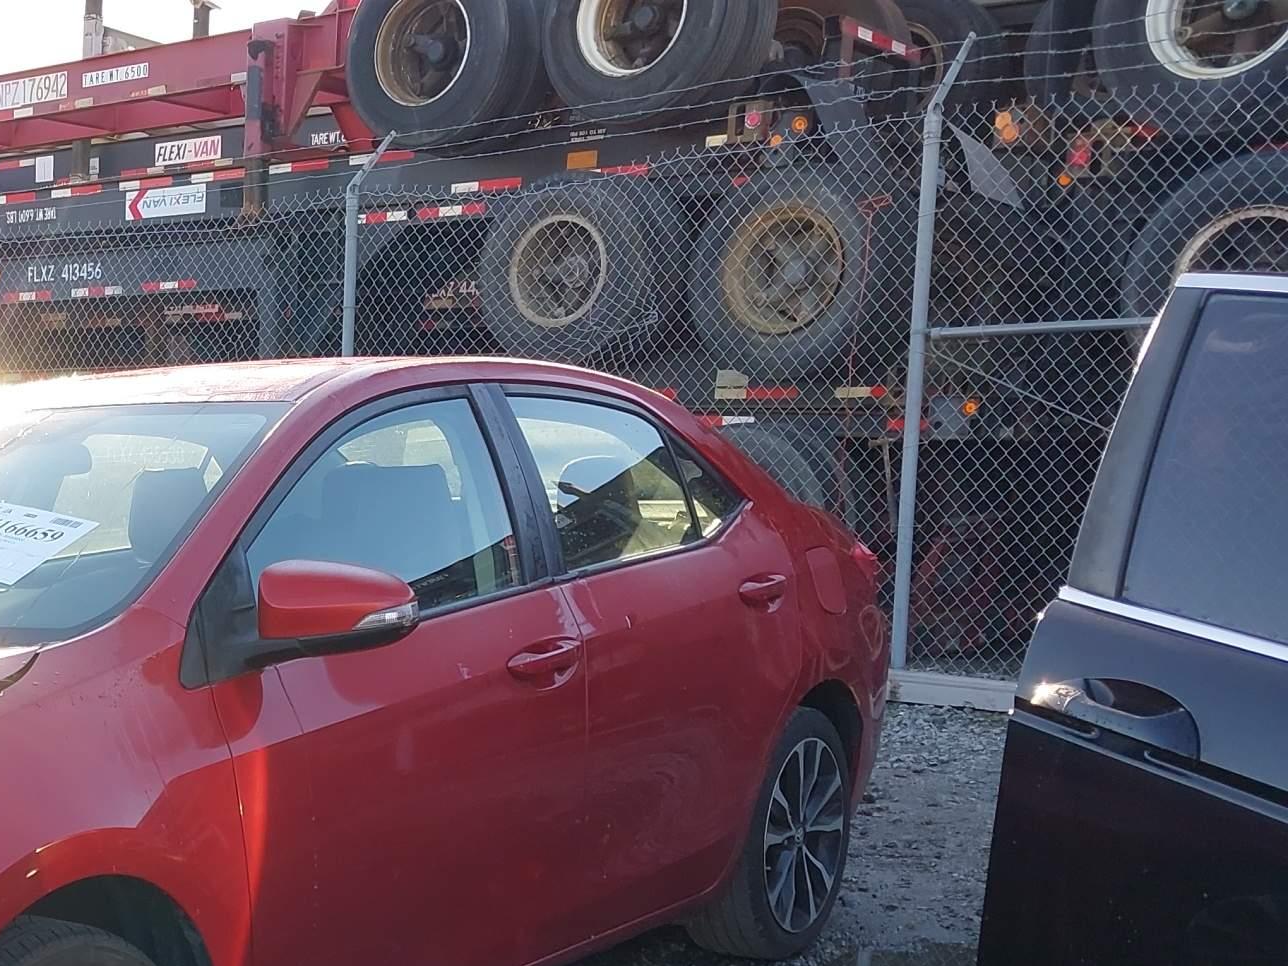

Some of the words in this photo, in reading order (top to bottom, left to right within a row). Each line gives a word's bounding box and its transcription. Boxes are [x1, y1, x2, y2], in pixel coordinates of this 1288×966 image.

[84, 72, 106, 86] TARE
[124, 64, 148, 80] 6500
[22, 73, 67, 103] 176942
[311, 132, 329, 146] TARE
[157, 138, 220, 163] FLEXI-VAN
[142, 194, 168, 209] VAN
[169, 191, 205, 208] FLEXI
[27, 264, 55, 283] FLXZ
[61, 262, 102, 282] 413456
